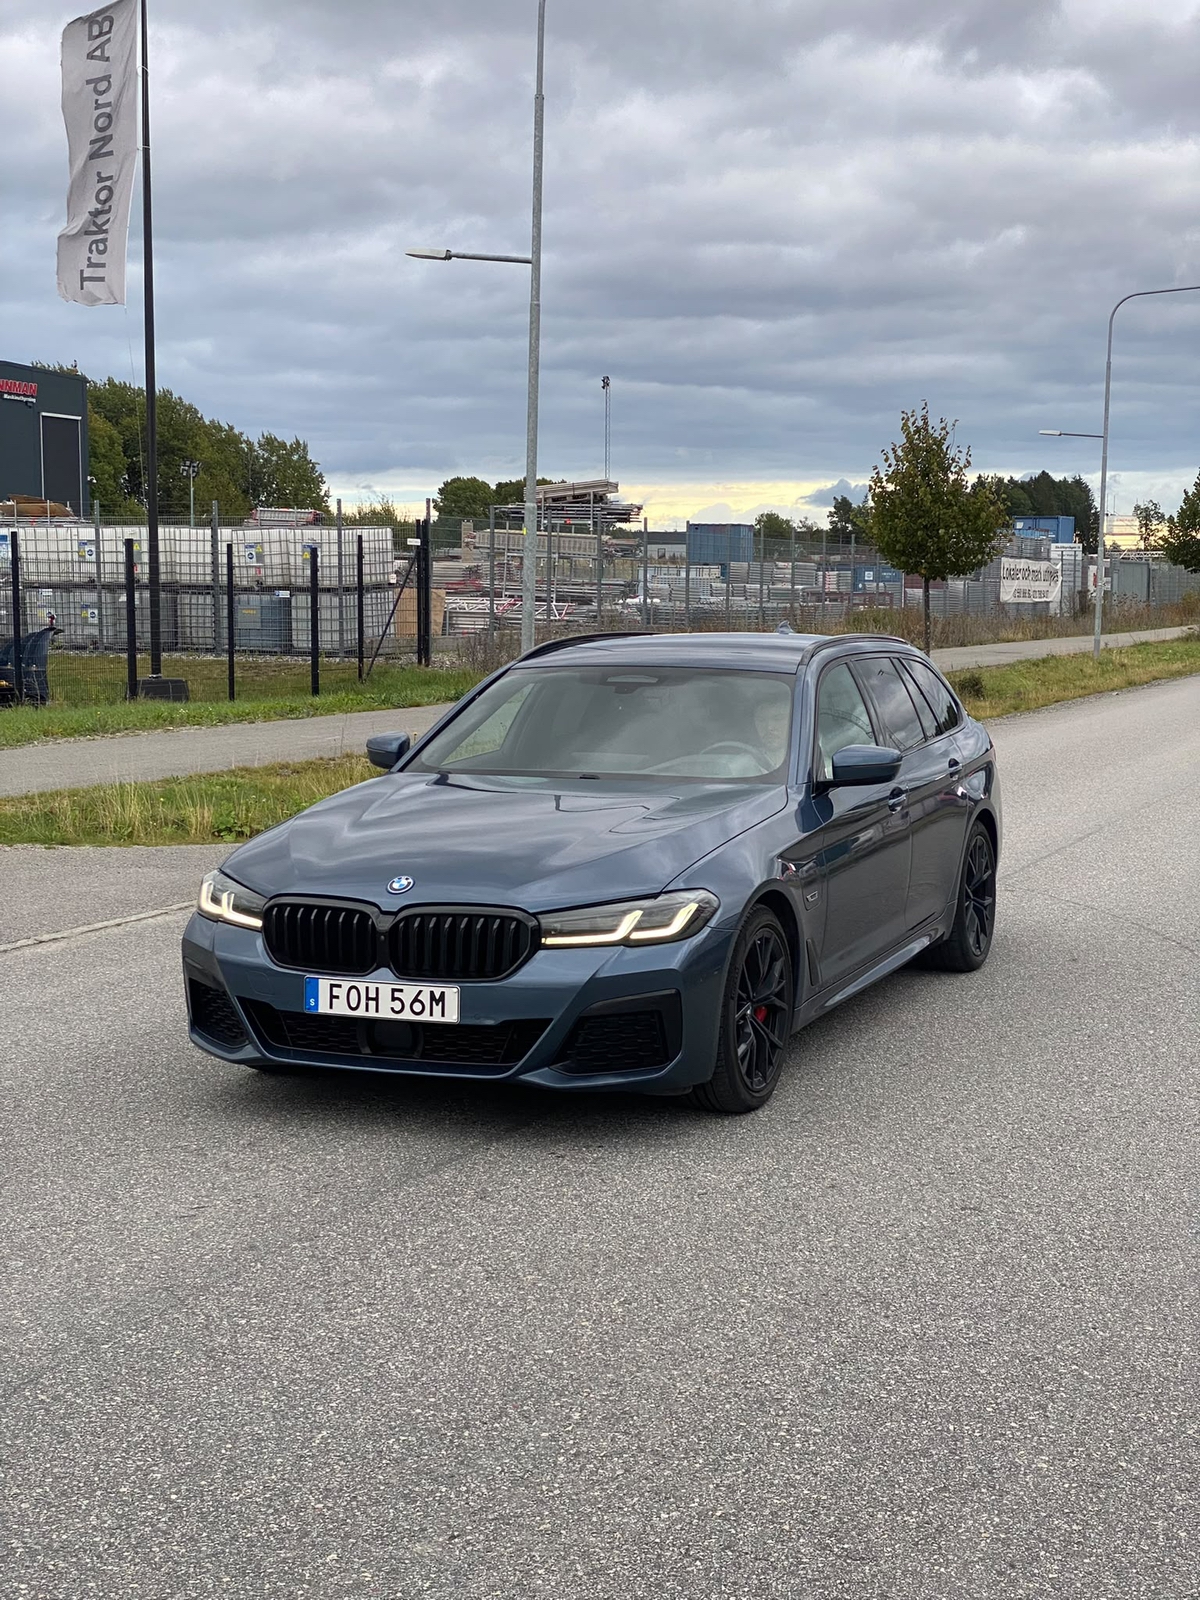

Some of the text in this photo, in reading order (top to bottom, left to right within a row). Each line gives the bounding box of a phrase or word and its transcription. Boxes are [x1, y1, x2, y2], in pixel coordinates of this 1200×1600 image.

[80, 15, 115, 290] Traktor Nord AB
[309, 998, 316, 1007] S
[329, 983, 446, 1018] FOH 56M
